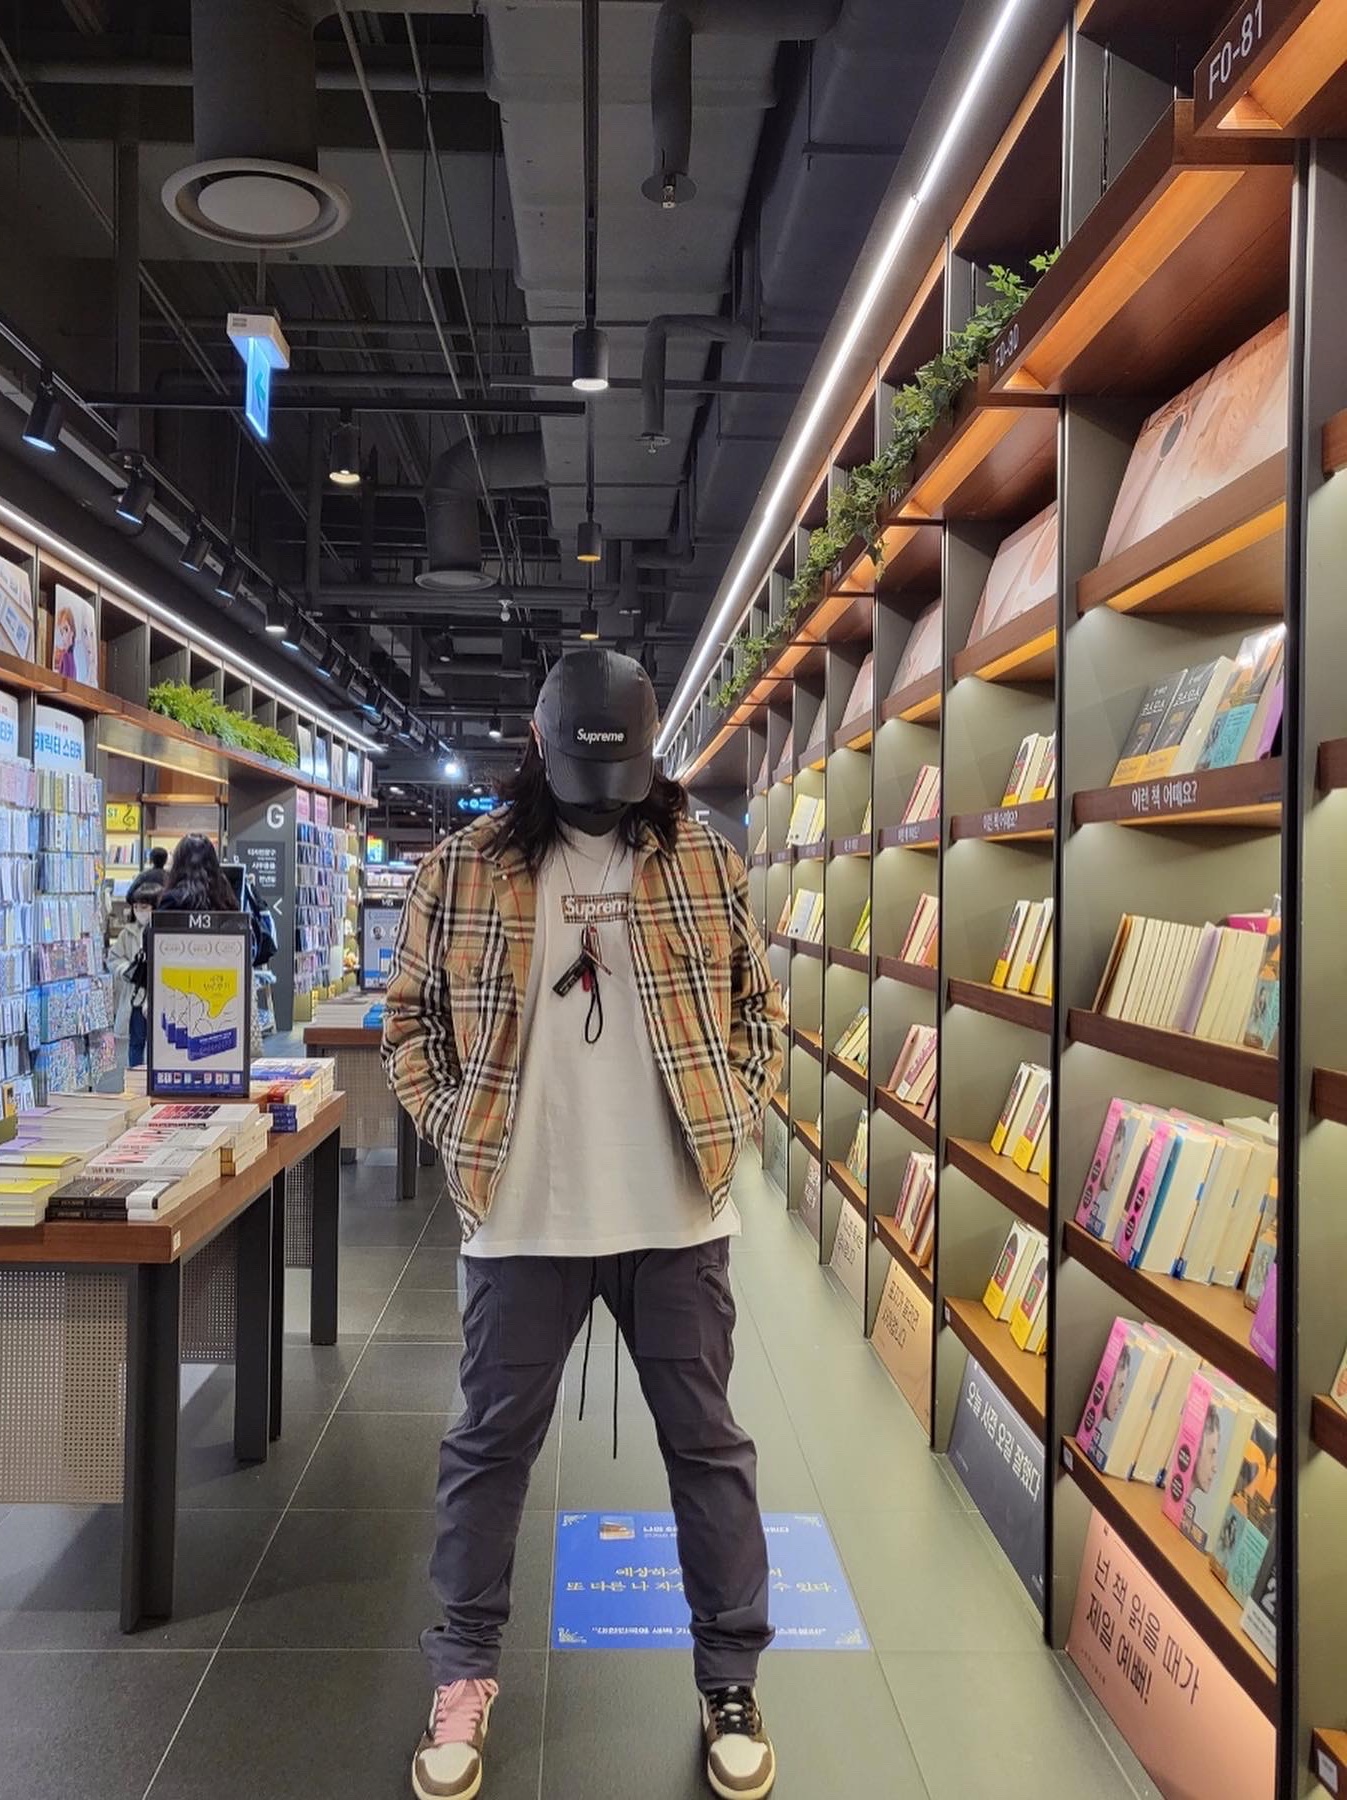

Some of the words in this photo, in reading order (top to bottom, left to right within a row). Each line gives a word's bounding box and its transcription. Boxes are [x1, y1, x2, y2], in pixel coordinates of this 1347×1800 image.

[1209, 0, 1262, 100] F0-81
[576, 727, 625, 744] Supreme
[1131, 786, 1149, 812] 이런
[1151, 783, 1161, 810] 책
[266, 803, 285, 829] G
[189, 913, 211, 929] M3
[564, 899, 628, 921] Suprem
[966, 1381, 982, 1418] 오늘
[995, 1422, 1015, 1464] 오길
[1086, 1592, 1115, 1653] 제일
[1116, 1633, 1153, 1705] 예뻐!
[1112, 1571, 1128, 1615] 책
[1128, 1593, 1161, 1656] 읽을
[1162, 1634, 1200, 1705] 때가
